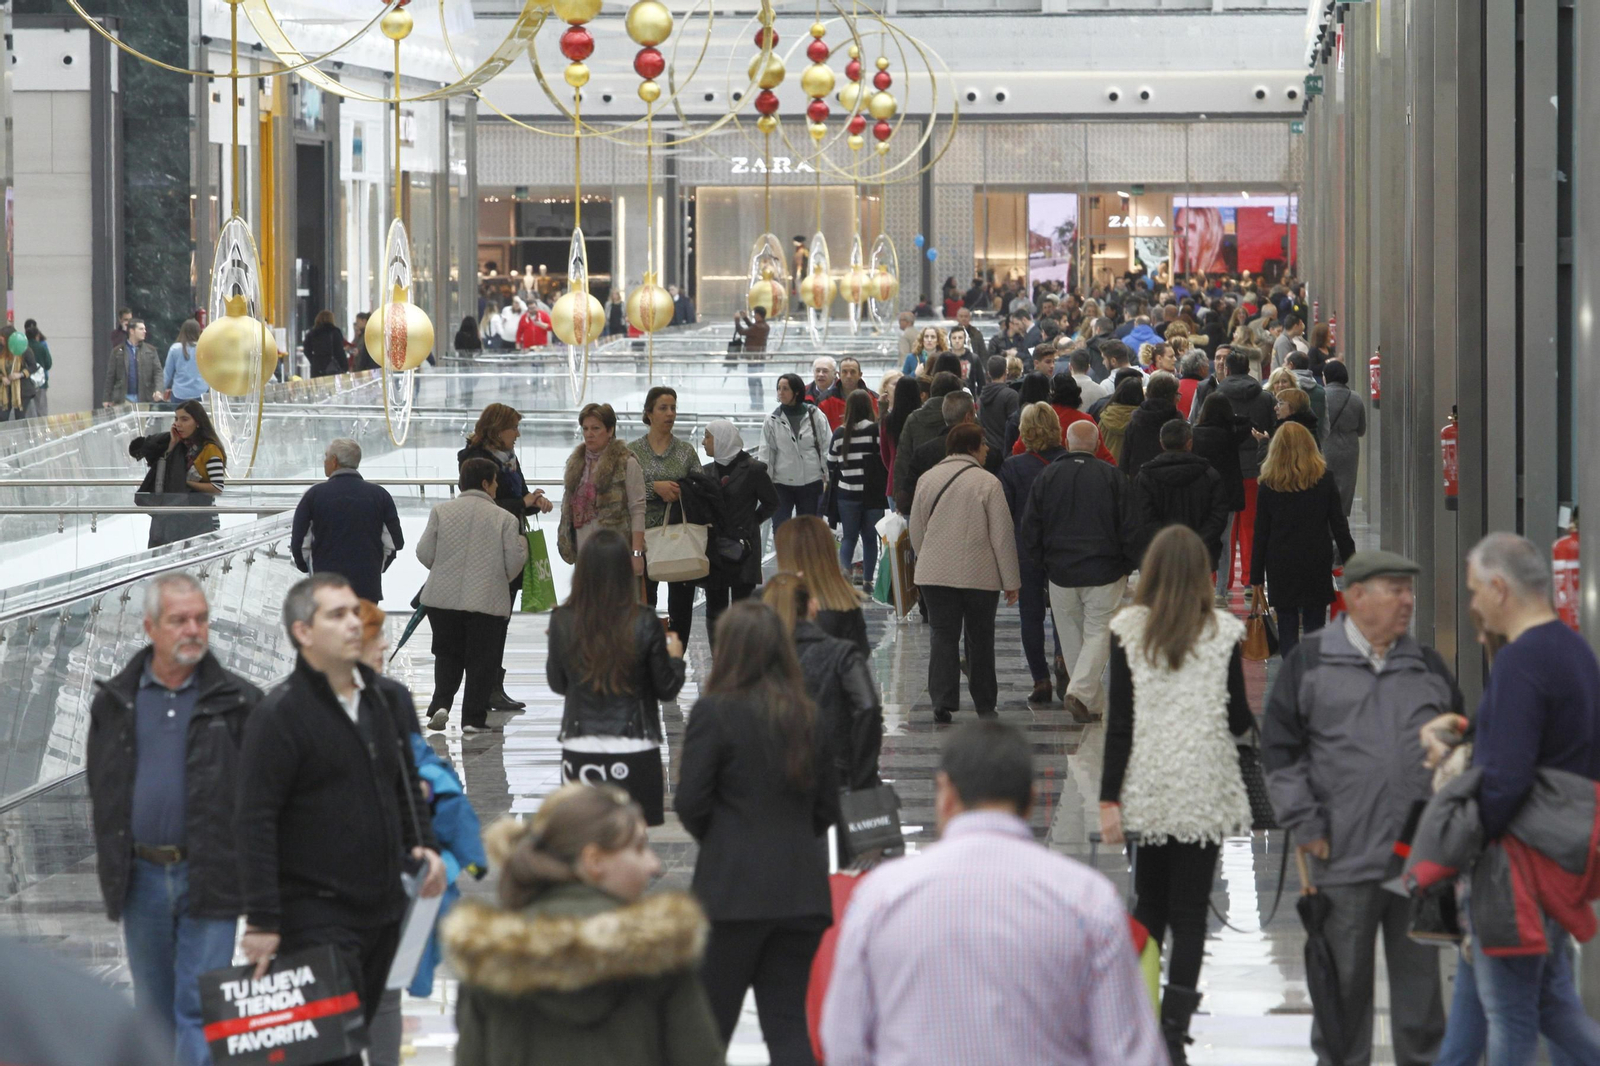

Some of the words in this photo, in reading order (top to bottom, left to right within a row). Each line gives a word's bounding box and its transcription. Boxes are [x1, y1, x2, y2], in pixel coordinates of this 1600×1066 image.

[731, 157, 816, 174] ZARA
[1108, 215, 1166, 228] ZARA
[220, 979, 249, 1001] TU
[251, 965, 316, 996] NUEVA
[234, 988, 306, 1018] TIENDA
[226, 1019, 319, 1056] FAVORITA
